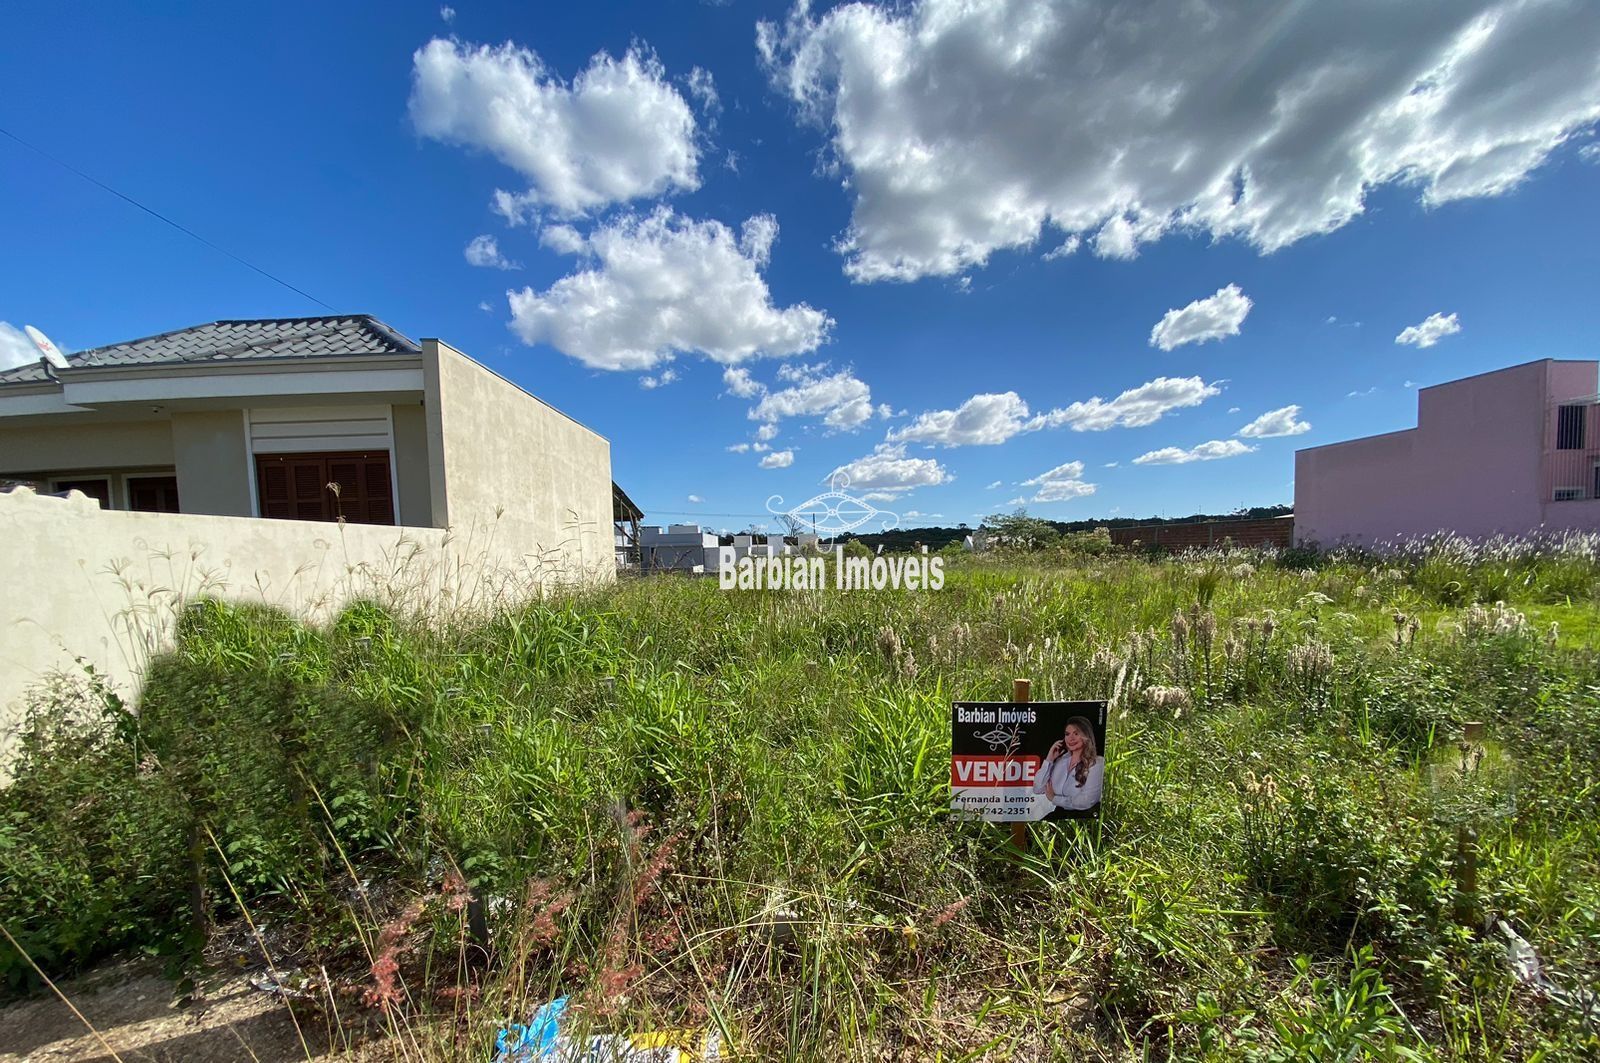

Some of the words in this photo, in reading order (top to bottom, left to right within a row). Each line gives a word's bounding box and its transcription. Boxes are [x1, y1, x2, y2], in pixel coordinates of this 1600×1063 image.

[957, 707, 996, 723] Barbian
[998, 707, 1037, 723] Imóveis
[955, 761, 1036, 782] VENDE
[955, 795, 1001, 803] Fernanda
[1004, 795, 1035, 803] Lemos
